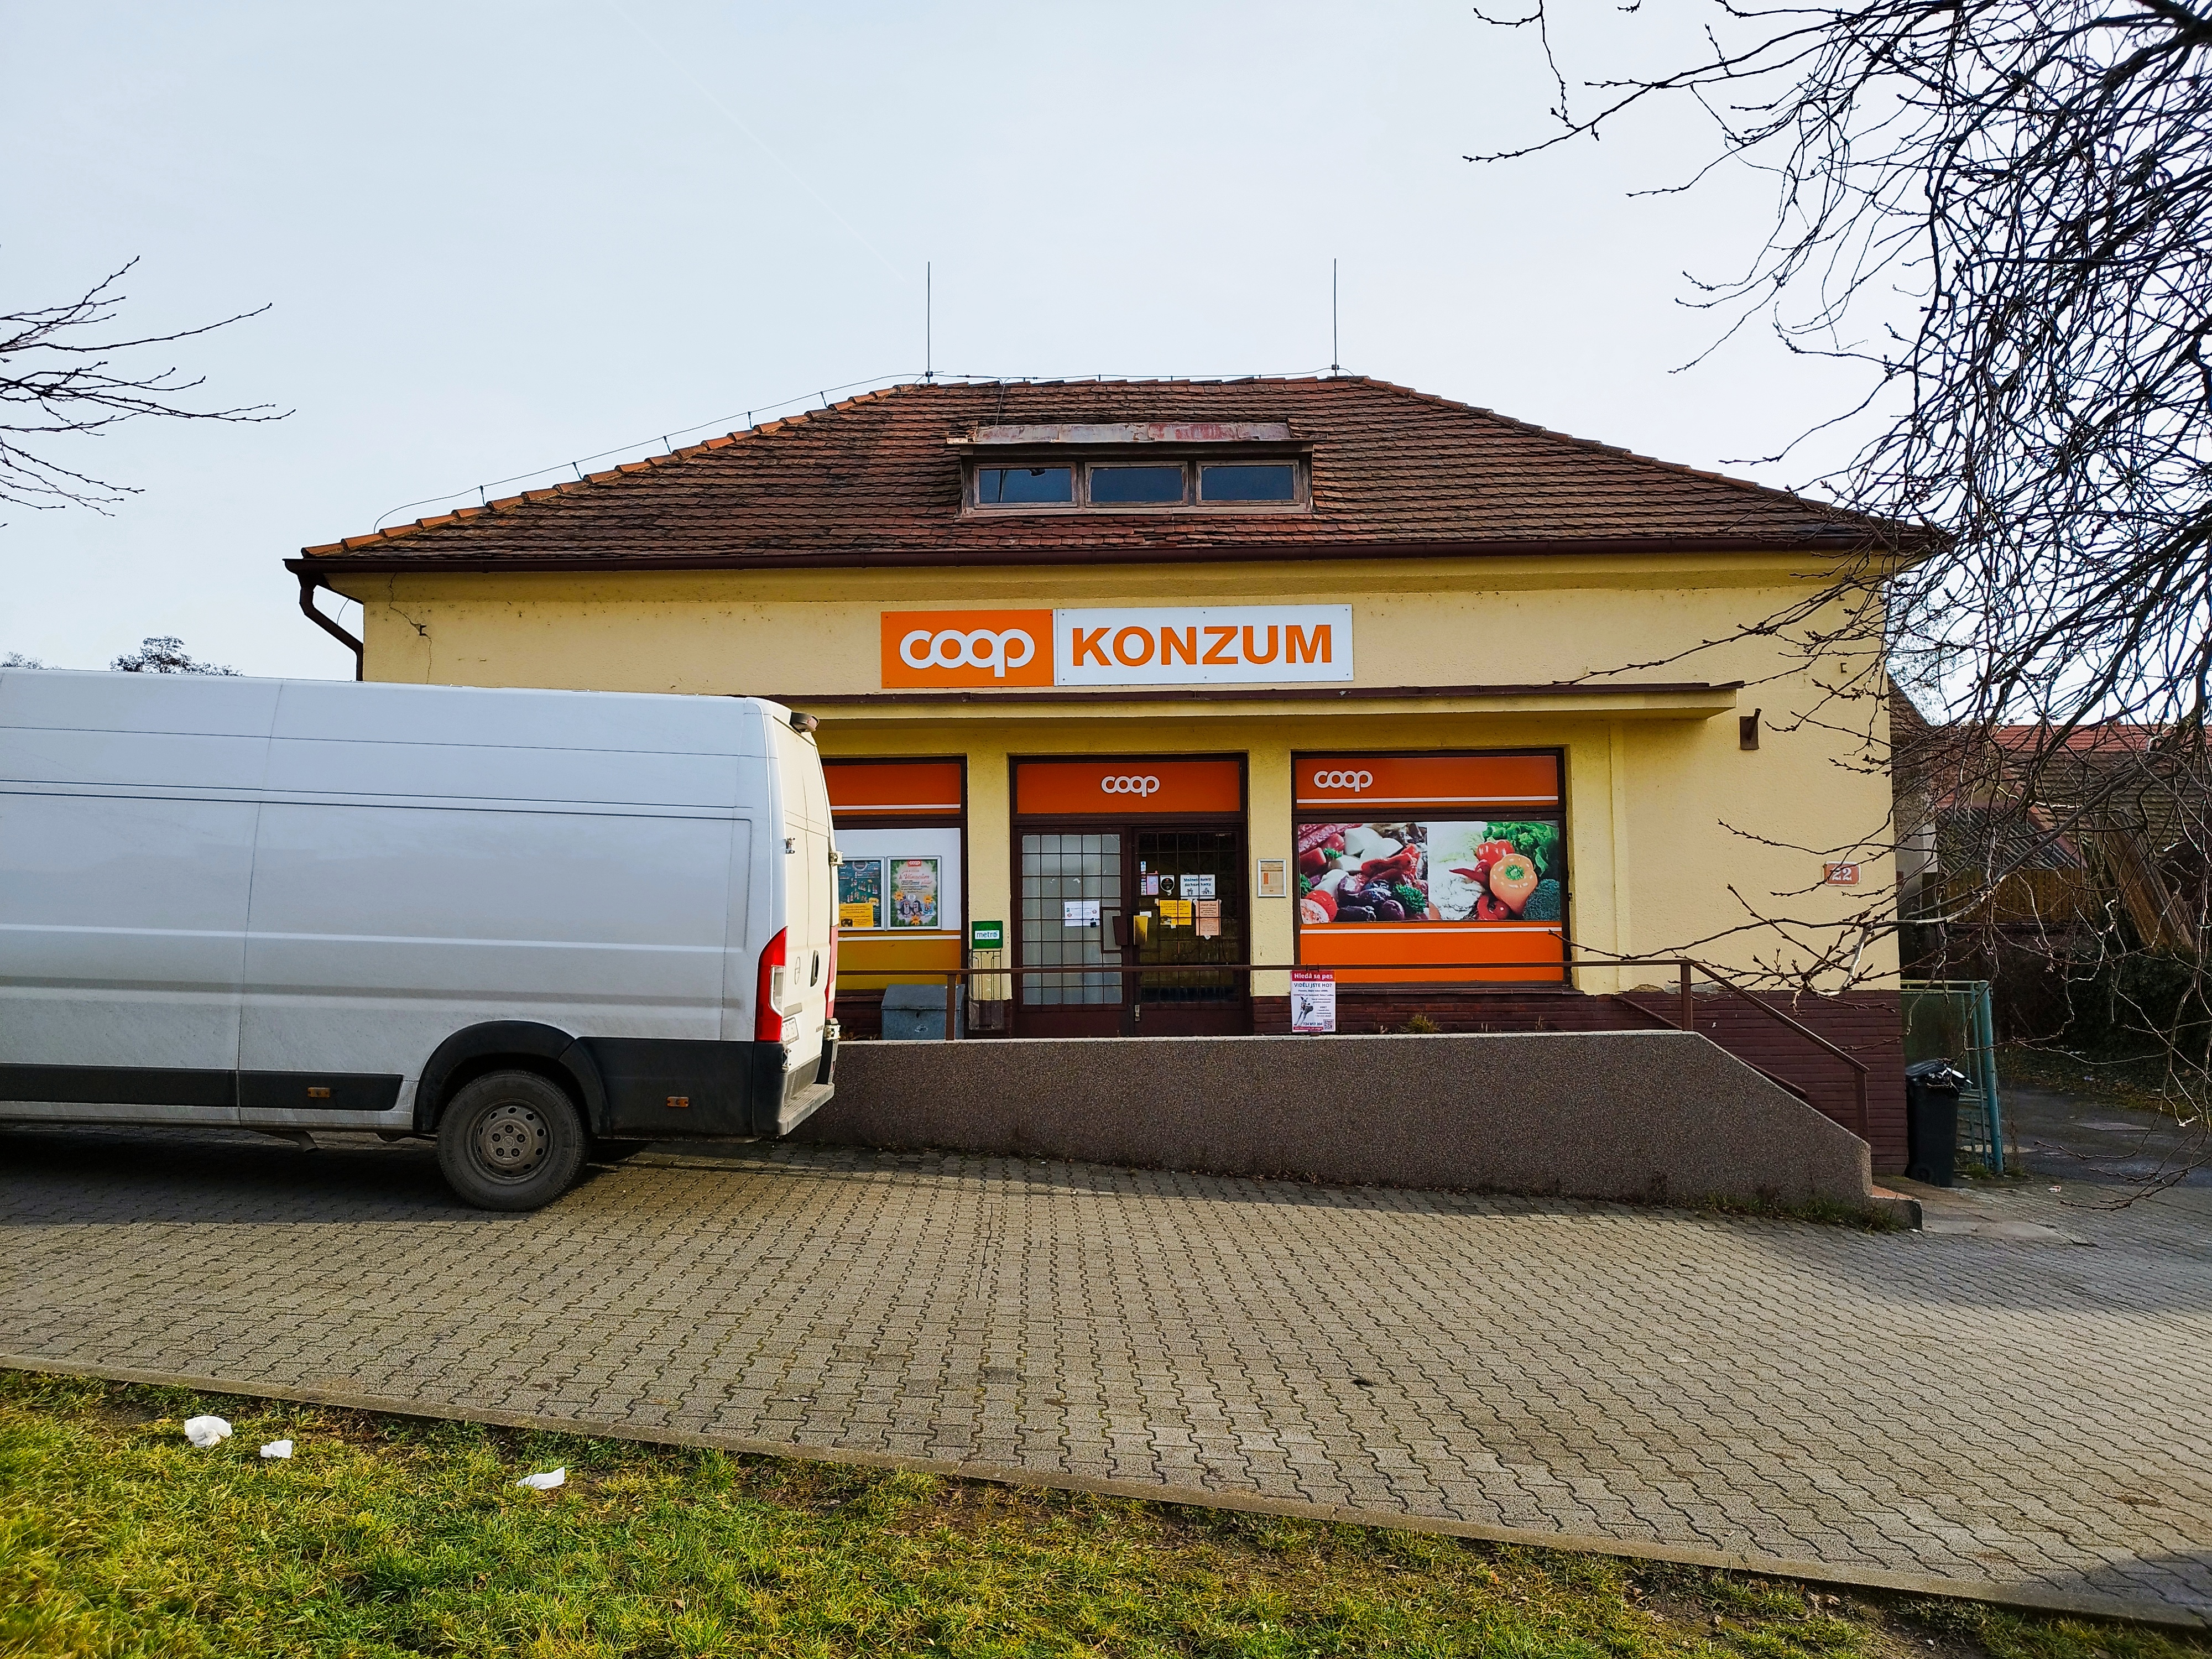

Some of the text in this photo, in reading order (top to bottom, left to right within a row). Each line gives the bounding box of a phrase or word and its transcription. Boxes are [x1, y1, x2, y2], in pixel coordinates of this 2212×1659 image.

[900, 624, 1333, 678] coop KONZUM
[1101, 775, 1160, 797] coop
[1314, 770, 1373, 792] coop
[1831, 867, 1852, 881] 22
